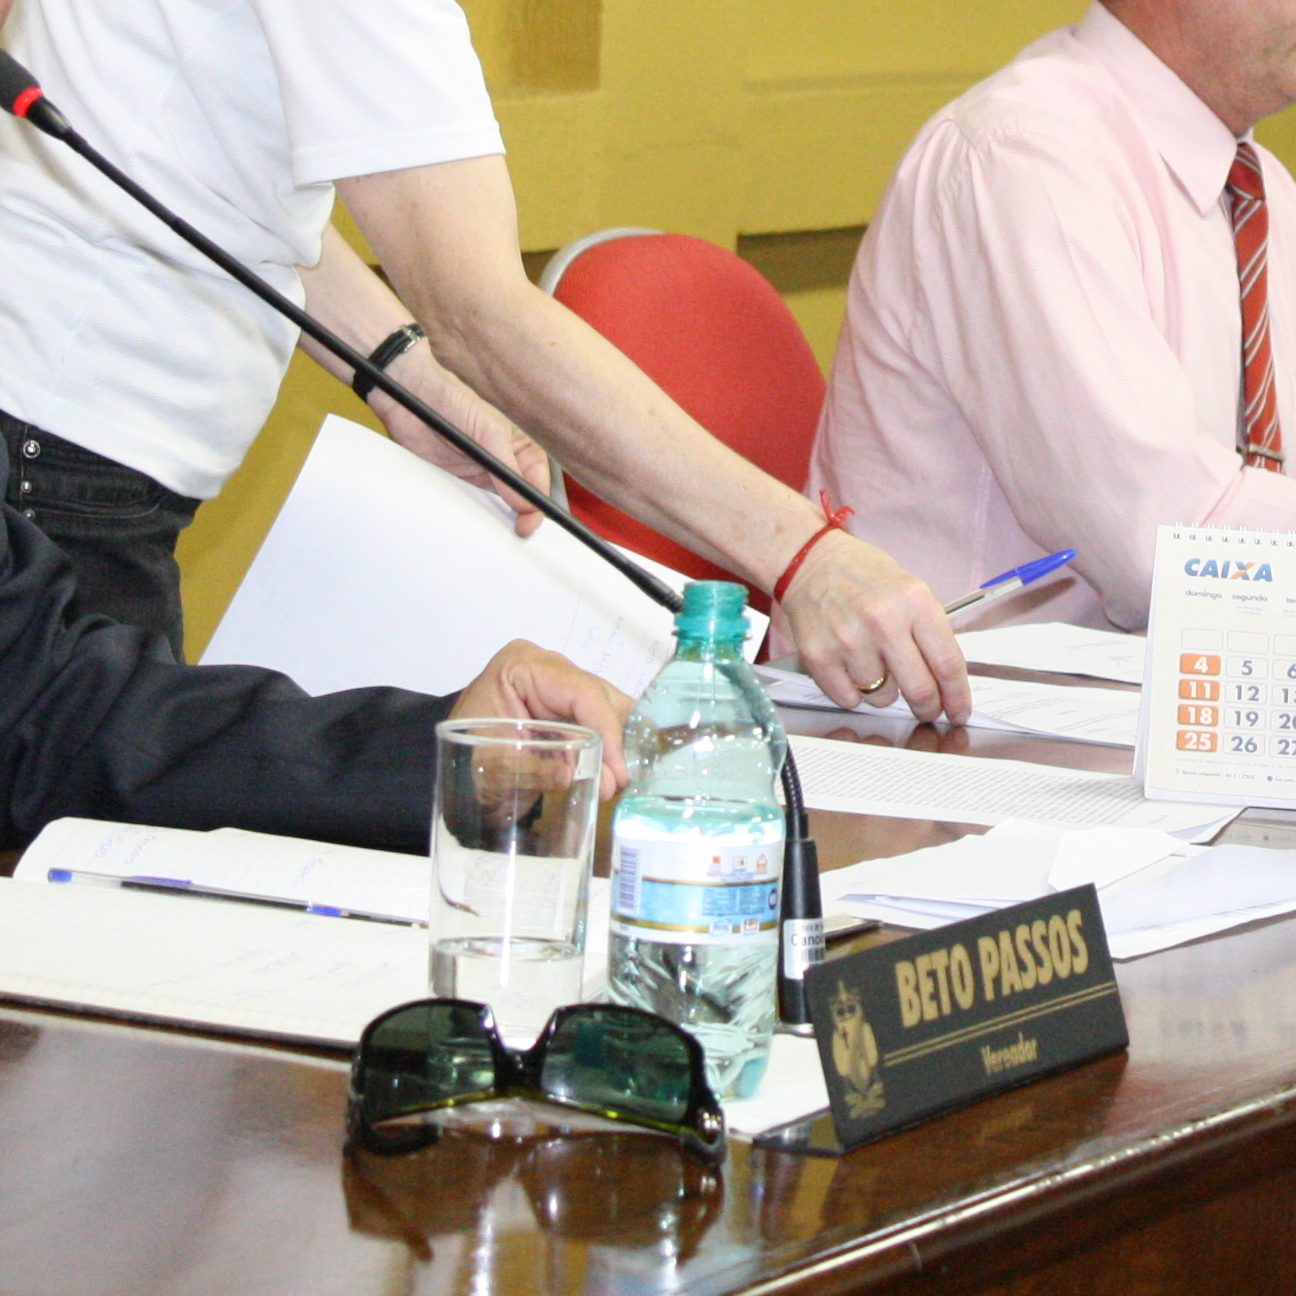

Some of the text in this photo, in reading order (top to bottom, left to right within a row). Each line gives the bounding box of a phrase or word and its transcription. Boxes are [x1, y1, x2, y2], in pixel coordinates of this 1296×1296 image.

[1184, 557, 1274, 583] CAIXA
[1193, 656, 1209, 674] 4
[1241, 660, 1253, 676] 5
[1189, 681, 1211, 699] 11
[1235, 684, 1260, 702] 12
[1187, 706, 1213, 725] 18
[1234, 710, 1260, 727] 19
[1184, 732, 1212, 751] 25
[1230, 735, 1258, 754] 26
[894, 909, 1089, 1029] BETO PASSOS
